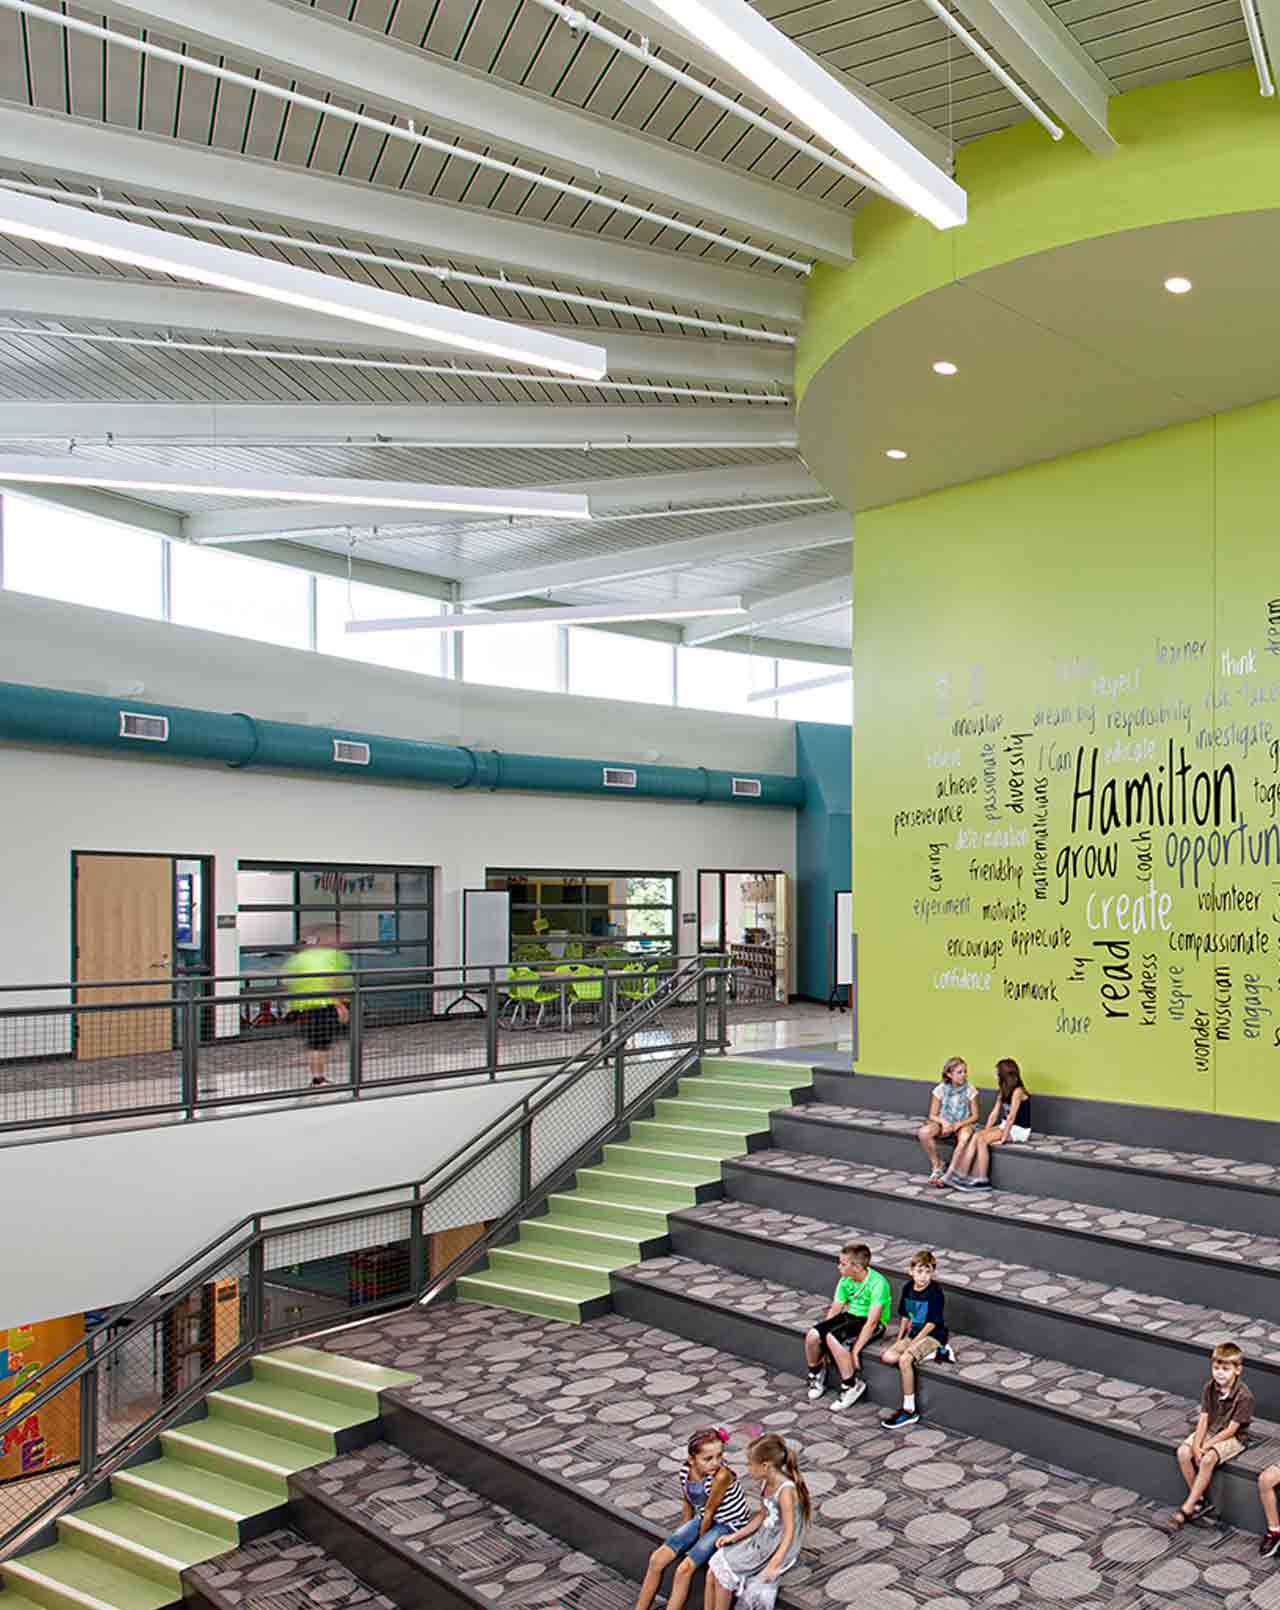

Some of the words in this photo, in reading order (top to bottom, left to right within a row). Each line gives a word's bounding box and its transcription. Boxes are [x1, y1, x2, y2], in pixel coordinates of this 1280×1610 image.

[1222, 648, 1256, 677] think
[1033, 703, 1072, 727] dream
[1106, 699, 1193, 734] responsibility
[1048, 742, 1072, 772] Can
[1195, 721, 1273, 759] investigate
[936, 774, 978, 799] achieve
[980, 743, 1002, 821] passionate
[1003, 731, 1034, 814] diversity
[1070, 738, 1237, 835] Hamilton
[893, 804, 963, 836] perseverance
[1032, 777, 1049, 900] mathematicians
[1131, 830, 1152, 882] coach
[928, 843, 948, 892] caring
[969, 855, 1024, 888] friendship
[1056, 842, 1118, 905] grow
[913, 896, 971, 924] experiment
[982, 899, 1027, 922] motivate
[1088, 879, 1173, 933] create
[1198, 882, 1263, 912] volunteer
[947, 938, 1003, 969] encourage
[1011, 928, 1072, 955] appreciate
[1169, 927, 1270, 960] compassionate
[1067, 956, 1094, 982] try
[1093, 939, 1133, 1020] read
[1003, 975, 1059, 1001] teamwork
[1136, 953, 1158, 1026] kindness
[1169, 965, 1192, 1021] inspire
[1214, 965, 1232, 1041] musician
[1056, 1009, 1090, 1035] share
[1243, 972, 1274, 1041] engage
[1191, 1009, 1210, 1072] wonder
